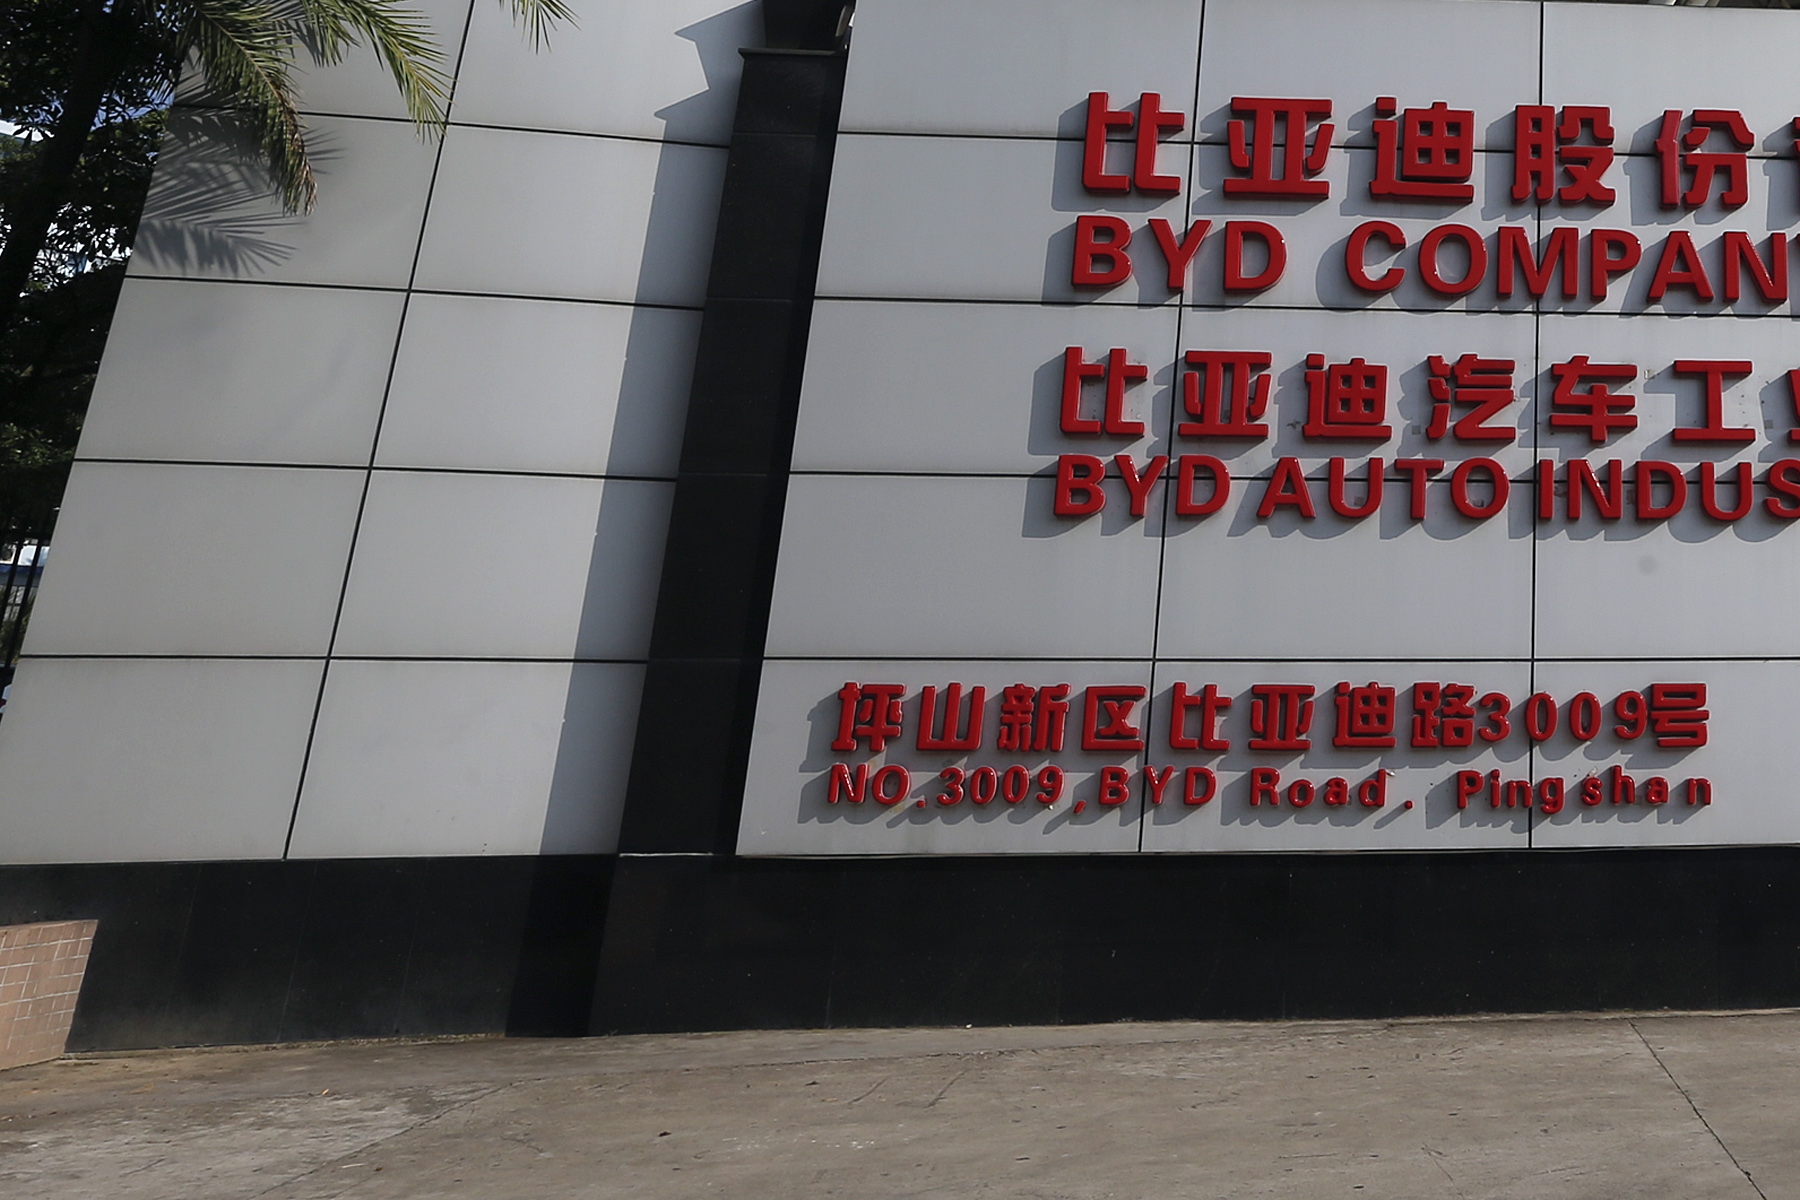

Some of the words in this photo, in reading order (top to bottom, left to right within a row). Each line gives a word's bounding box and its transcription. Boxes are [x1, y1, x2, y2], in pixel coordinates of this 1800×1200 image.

[1072, 214, 1287, 291] BYD
[1053, 454, 1232, 518] BYD
[1257, 456, 1510, 520] AUTO
[831, 681, 1710, 753] 坪山新区比亚迪路3009号
[1456, 765, 1712, 814] Pingshan
